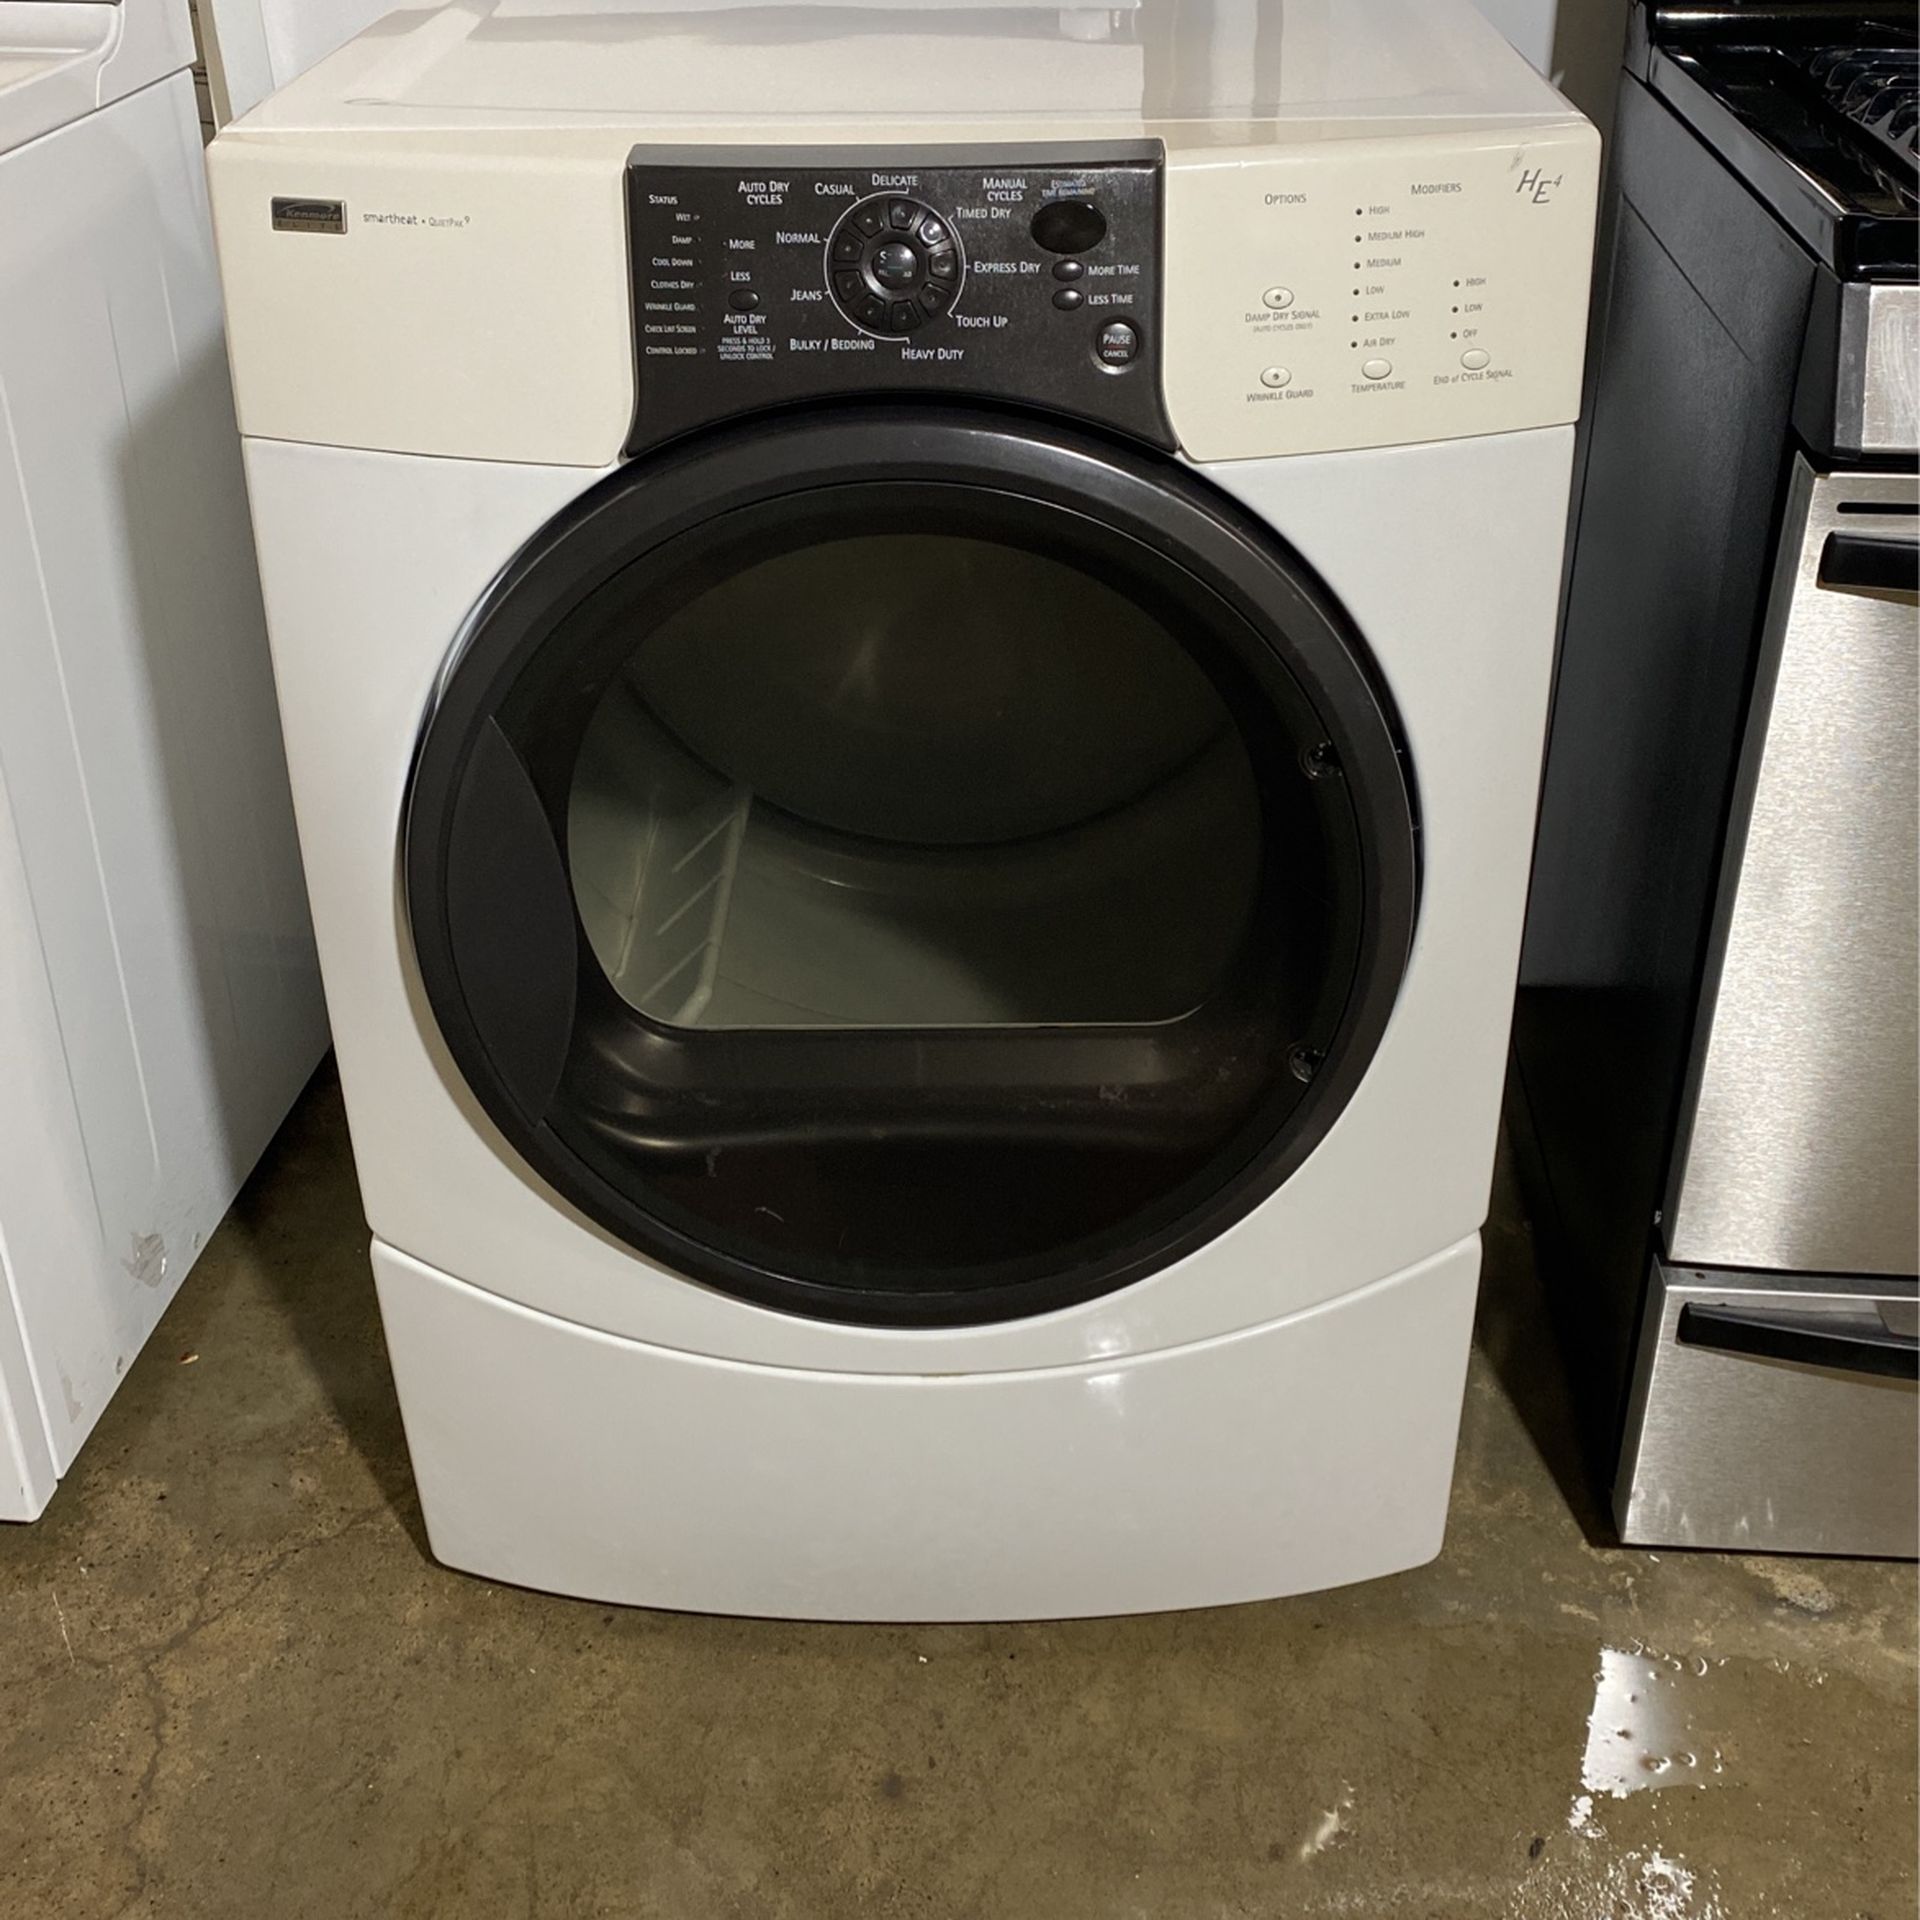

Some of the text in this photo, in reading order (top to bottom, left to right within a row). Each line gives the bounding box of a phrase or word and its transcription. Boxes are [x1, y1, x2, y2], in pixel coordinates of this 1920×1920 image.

[872, 174, 918, 186] DELICATE
[983, 178, 1028, 189] MANUAL
[738, 181, 790, 193] AUTO DRY
[815, 183, 855, 195] CASUAL
[1411, 183, 1462, 195] MODIFIERS
[649, 194, 678, 205] STATUS
[747, 194, 783, 205] CYCLES
[987, 191, 1023, 202] CYCLES
[1265, 193, 1307, 205] OPTIONS
[956, 207, 1011, 218] TIMED DRY
[1369, 206, 1390, 215] HIGH
[363, 214, 417, 225] smartheat
[672, 235, 692, 244] DAMP
[776, 232, 820, 244] NORMAL
[1368, 230, 1424, 241] MEDIUM HIGH
[729, 239, 755, 250] MORE
[672, 258, 693, 266] DOWN
[974, 262, 1041, 273] EXPRESS DRY
[1367, 258, 1402, 268] MEDIUM
[1089, 265, 1140, 275] MORE TIME
[731, 271, 751, 281] LESS
[1466, 278, 1486, 286] HIGH
[790, 290, 822, 301] JEANS
[1366, 286, 1384, 295] LOW
[1089, 294, 1133, 304] LESS TIME
[1465, 304, 1483, 313] LOW
[723, 314, 766, 324] AUTO DRY
[956, 315, 1008, 327] TOUCH UP
[1245, 310, 1320, 323] DAMP DRY SIGNAL
[1364, 310, 1410, 321] EXTRA LOW
[734, 325, 758, 335] LEVEL
[1463, 329, 1478, 338] OFF
[790, 339, 822, 351] BULKY
[831, 339, 875, 350] BEDDING
[1103, 334, 1131, 345] PAUSE
[1363, 337, 1396, 347] AIR DRY
[902, 348, 964, 360] HEAVY DUTY
[1103, 350, 1128, 358] CANCEL
[1433, 376, 1449, 385] END
[1461, 372, 1484, 382] CYCLE
[1486, 370, 1513, 380] SIGNAL
[1351, 381, 1406, 393] TEMPERATURE
[1247, 389, 1313, 402] WRINKLE GUARD
